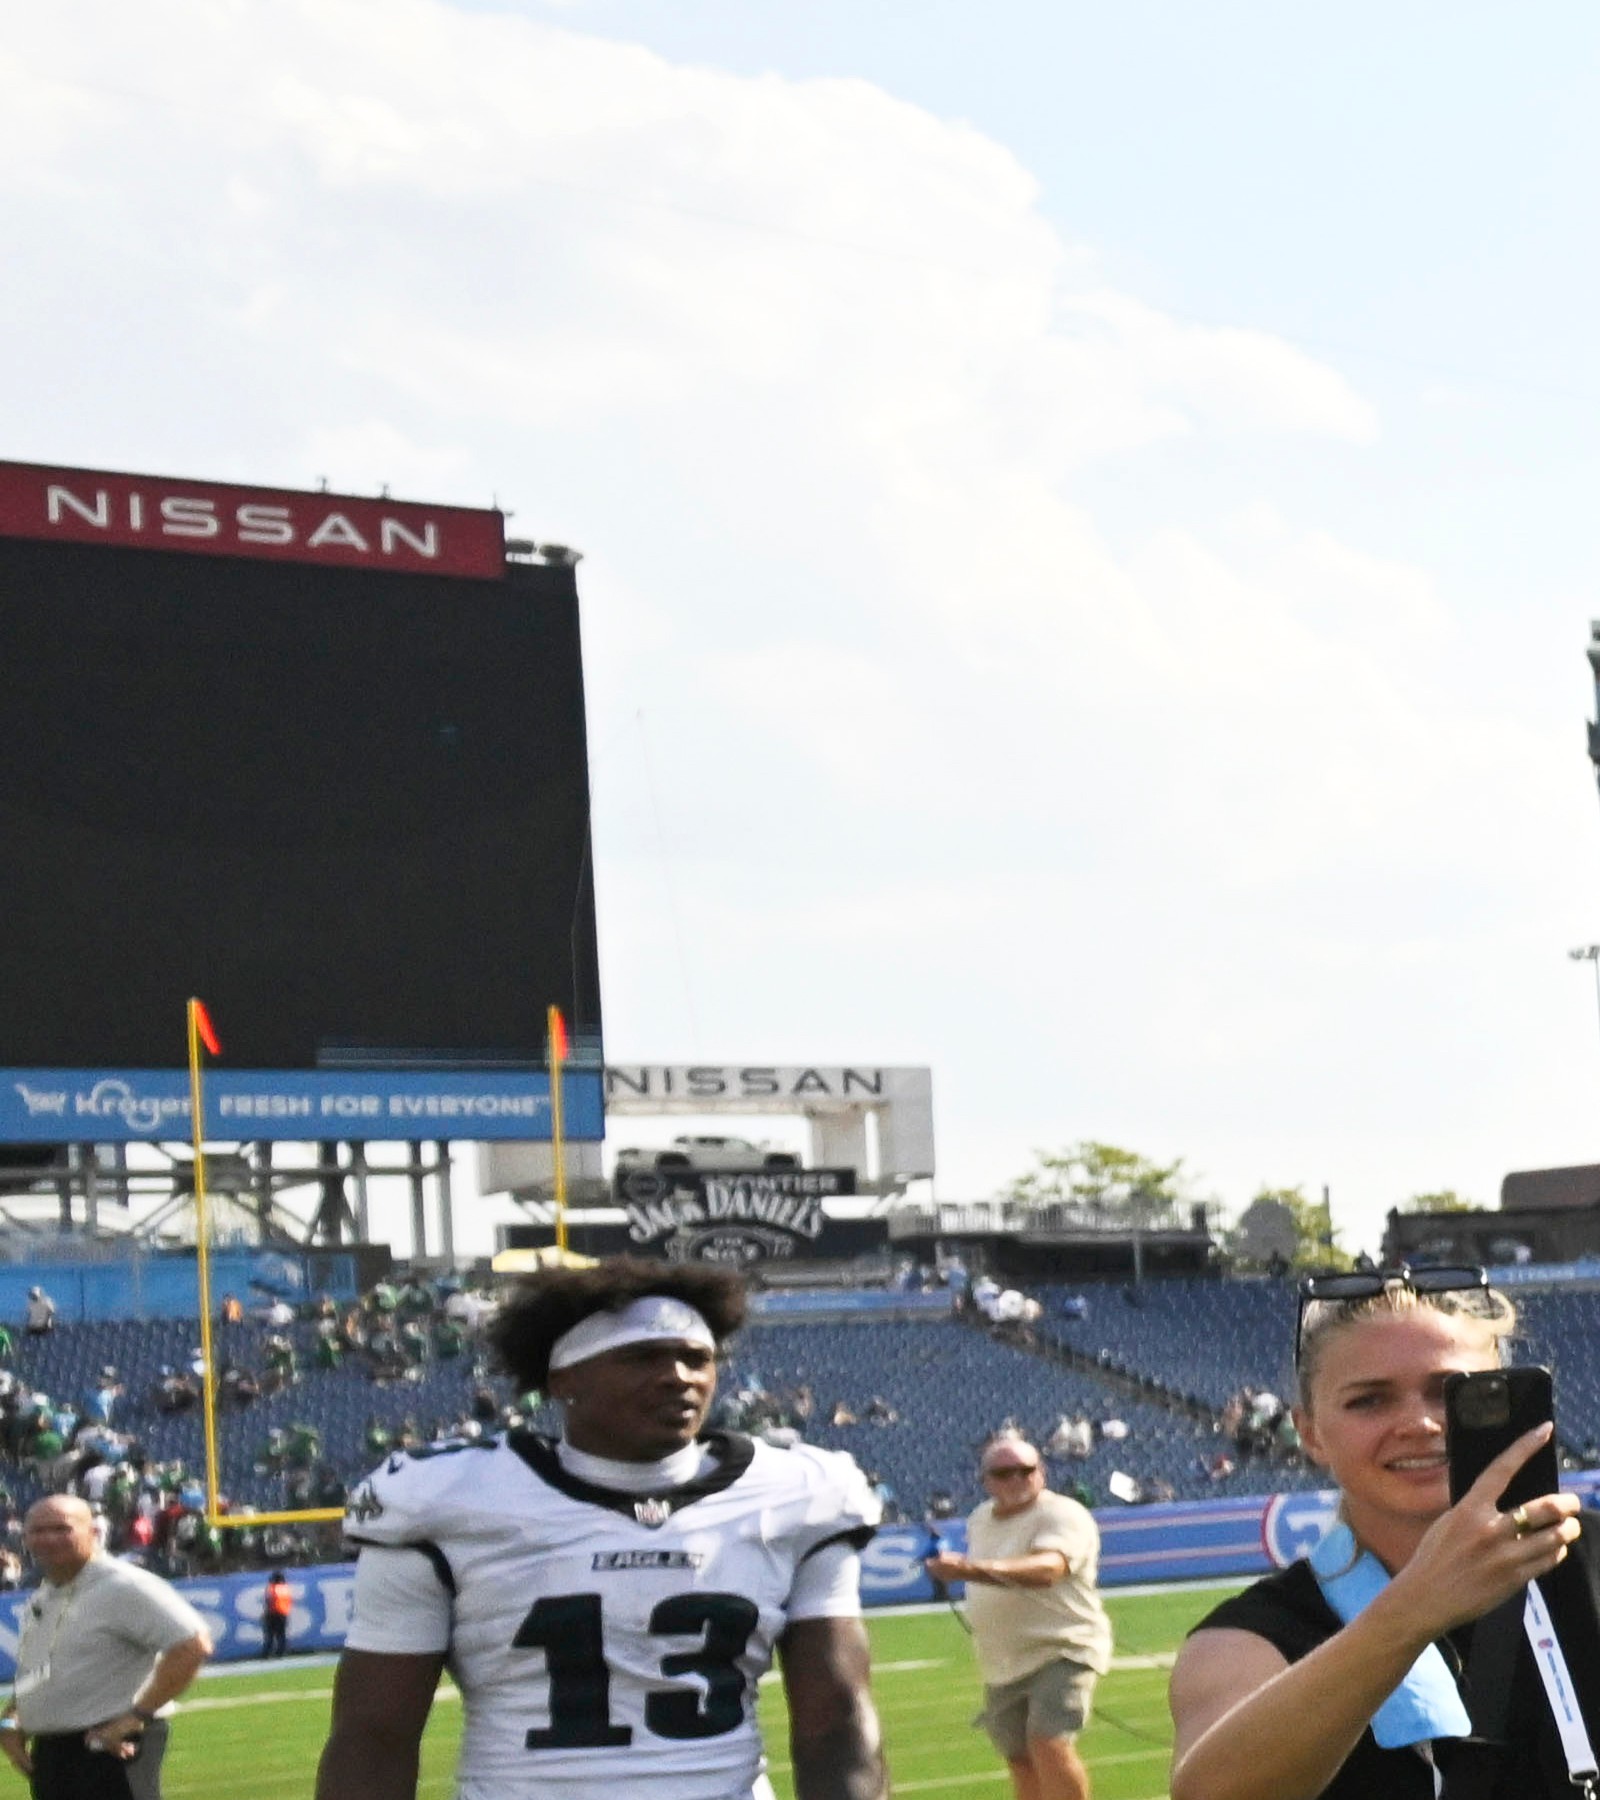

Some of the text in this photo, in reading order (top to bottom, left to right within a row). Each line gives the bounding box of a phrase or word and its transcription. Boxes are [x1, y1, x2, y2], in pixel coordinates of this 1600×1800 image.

[47, 484, 439, 560] NISSAN
[219, 1094, 309, 1118] FRESH
[321, 1094, 378, 1117] FOR
[604, 1066, 882, 1096] NISSAN
[512, 1592, 760, 1750] 13
